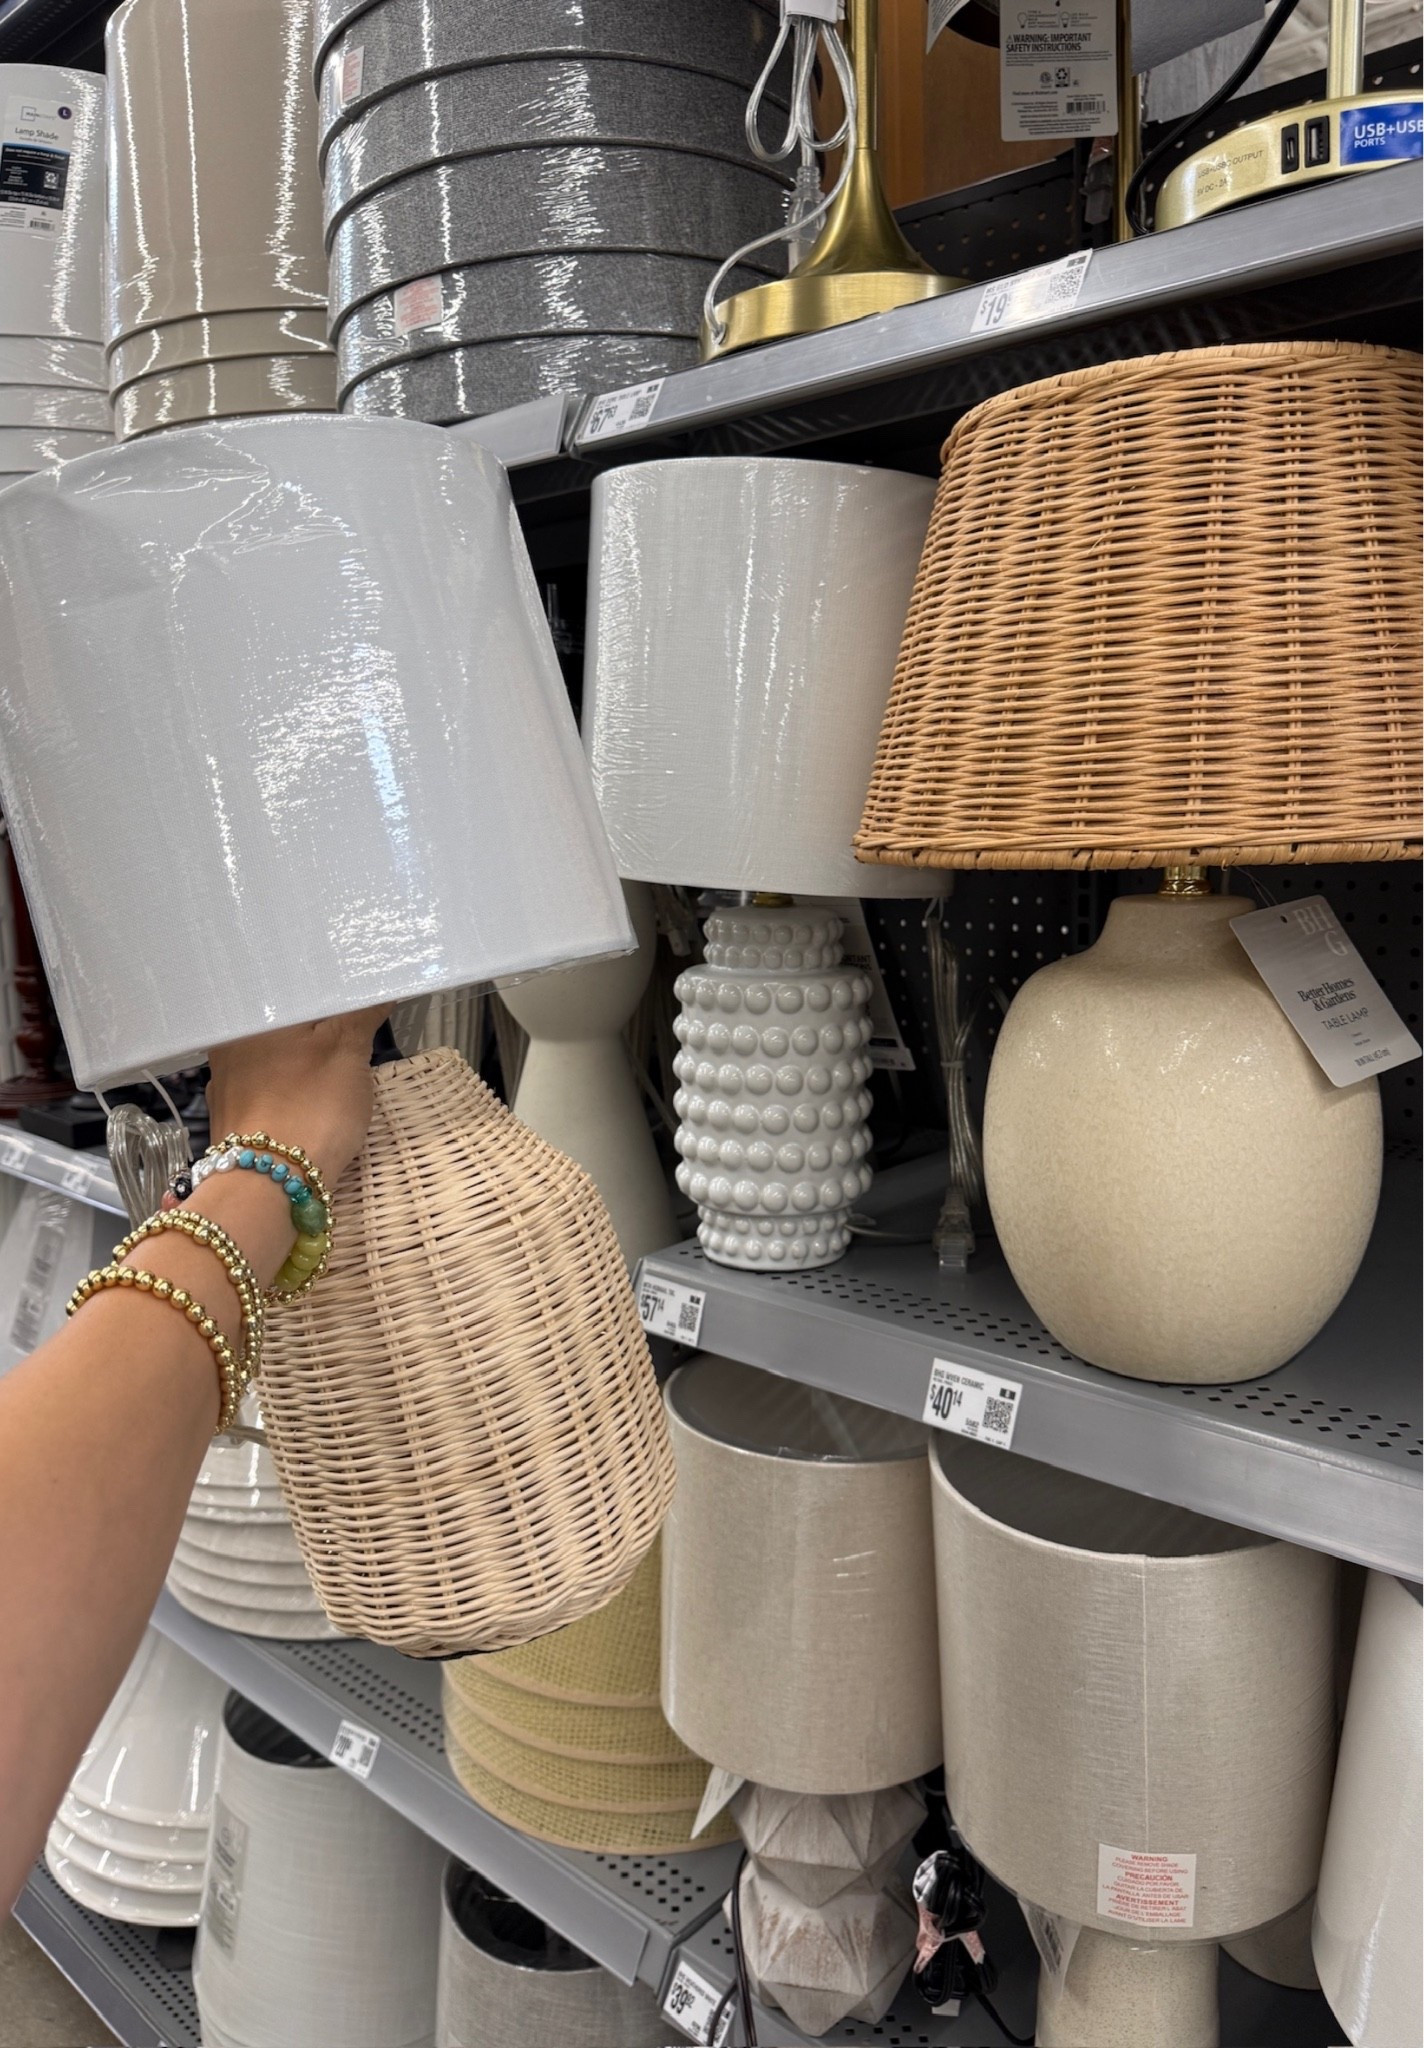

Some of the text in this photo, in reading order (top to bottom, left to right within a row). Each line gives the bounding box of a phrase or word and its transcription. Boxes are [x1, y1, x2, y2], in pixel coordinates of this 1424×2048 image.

[1013, 33, 1092, 43] WARNING: IMPORTANT
[1006, 43, 1081, 53] SAFETY INSTRUCTIONS
[15, 127, 35, 137] Lamp
[36, 129, 59, 141] Shade
[1354, 136, 1386, 149] PORTS
[1232, 150, 1264, 165] OUTPUT
[1297, 978, 1354, 1002] Better Homes
[1312, 990, 1356, 1012] & Gardens
[1321, 1007, 1369, 1031] TABLE LAMP
[961, 1376, 984, 1391] CERAMIC
[1131, 1854, 1168, 1862] WARNING
[1116, 1894, 1179, 1906] AVERTISSEMENT
